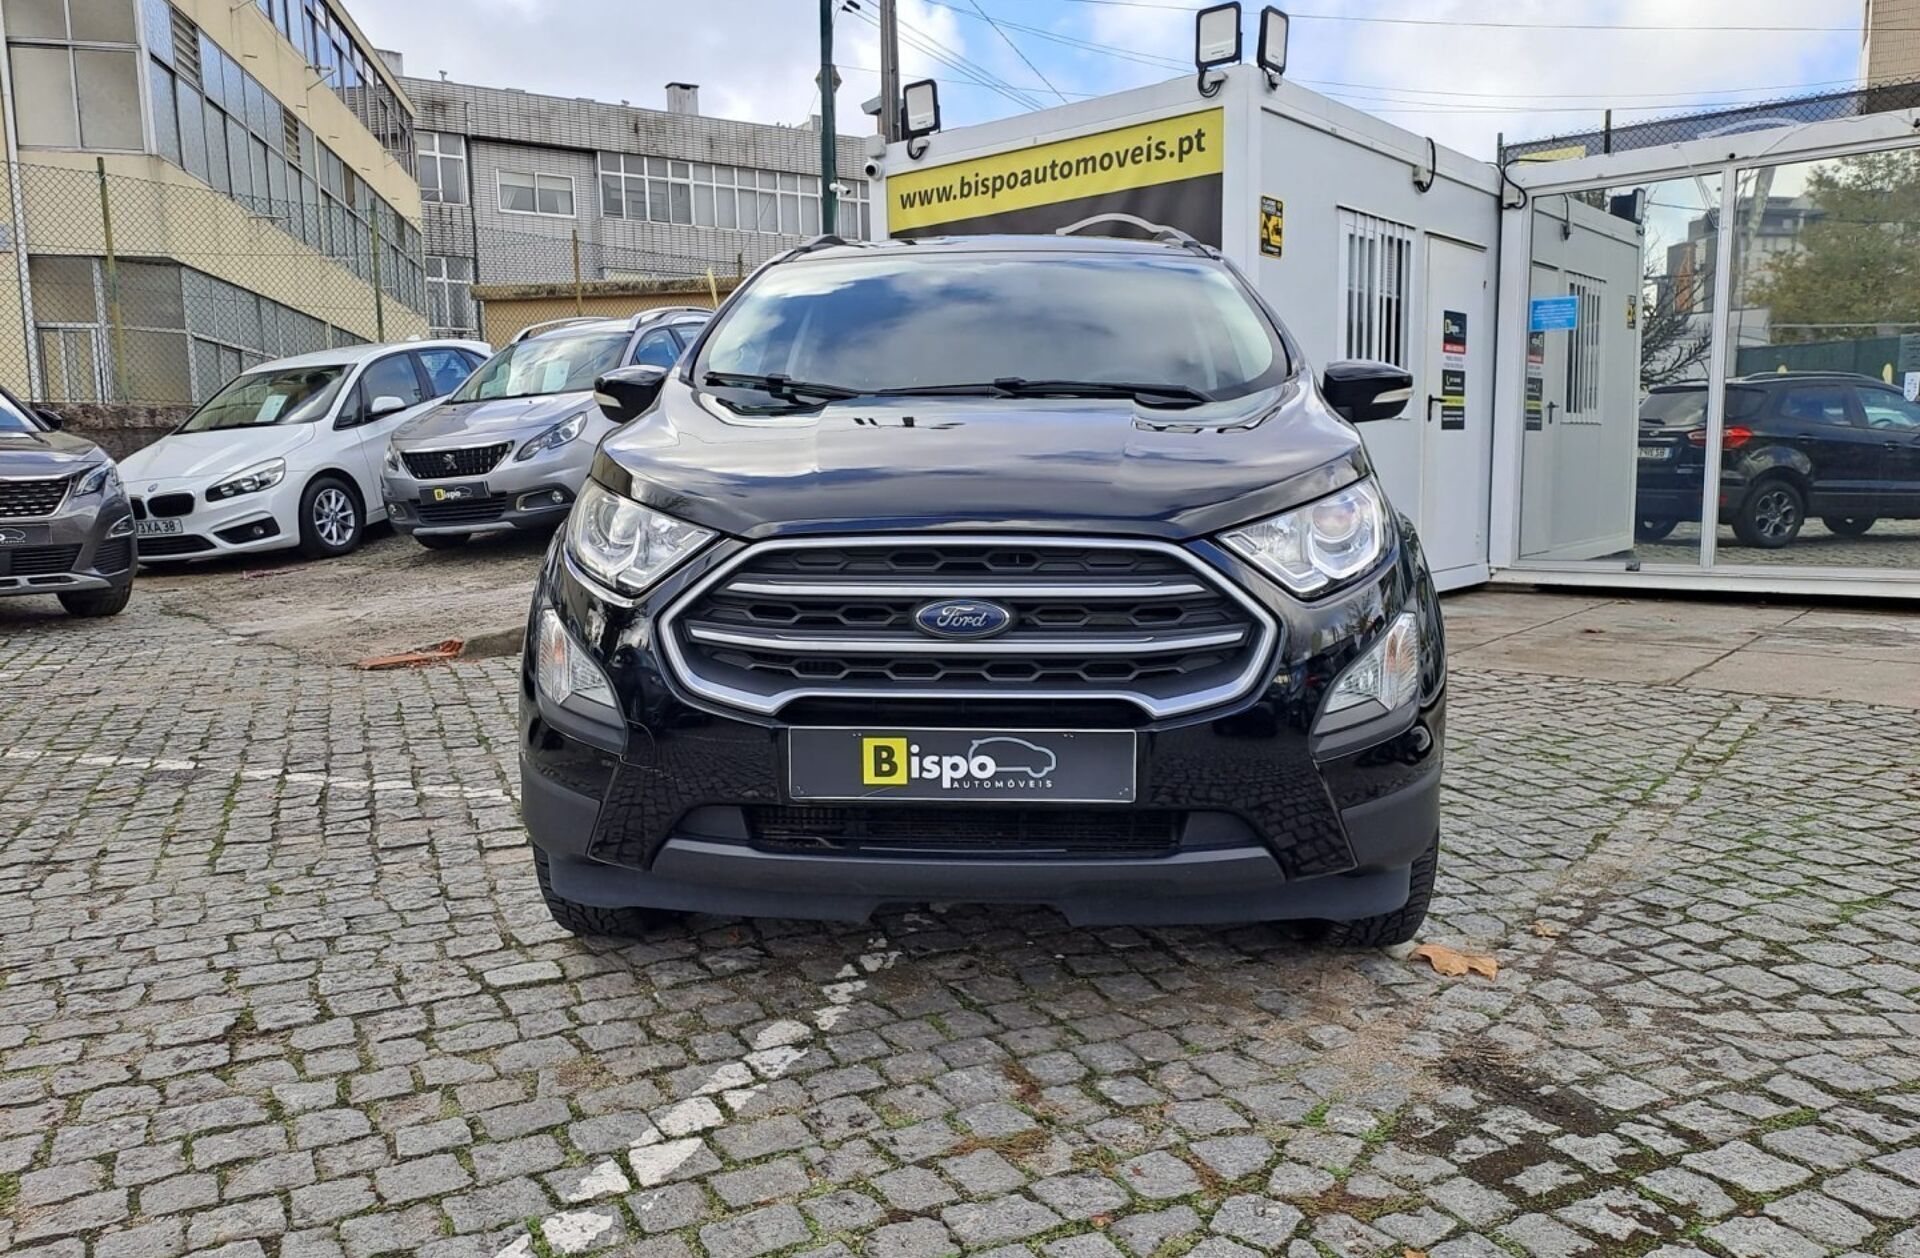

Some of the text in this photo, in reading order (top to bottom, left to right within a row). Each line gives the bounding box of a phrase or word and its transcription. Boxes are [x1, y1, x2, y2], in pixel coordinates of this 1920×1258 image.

[900, 128, 1206, 211] www.bispoautomoveis.pt
[936, 605, 987, 628] Ford
[872, 743, 997, 789] Bispo
[952, 778, 1053, 789] AUTOMÓVEIS
